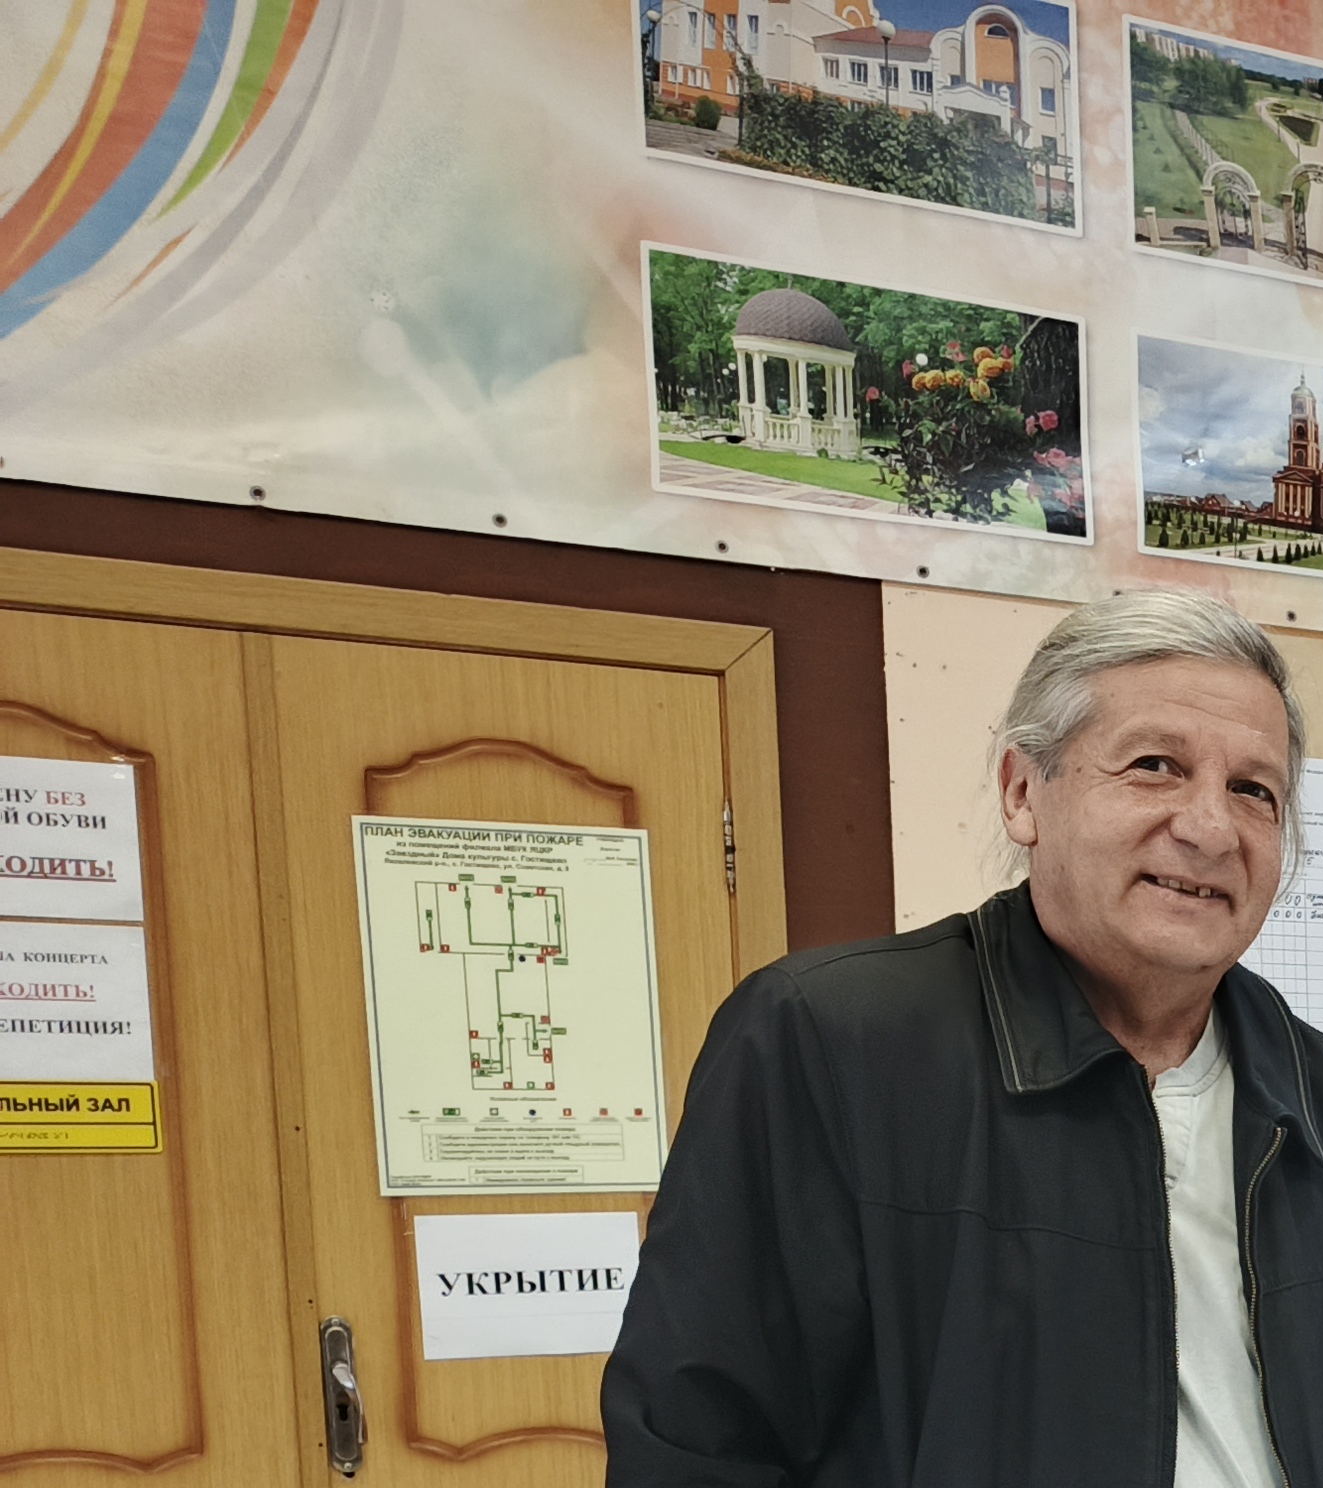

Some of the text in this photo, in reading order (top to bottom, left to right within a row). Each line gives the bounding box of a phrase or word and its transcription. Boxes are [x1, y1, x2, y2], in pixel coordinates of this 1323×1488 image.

[0, 788, 86, 806] НУ БЕЗ
[0, 806, 107, 829] Й ОБУВИ
[364, 826, 585, 846] ПЛАН ЭВАКУАЦИИ ПРИ ПОЖАРЕ
[23, 952, 109, 965] КОНЦЕРТА
[86, 1098, 131, 1112] ЗАЛ
[437, 1267, 625, 1297] УКРЫТИЕ
